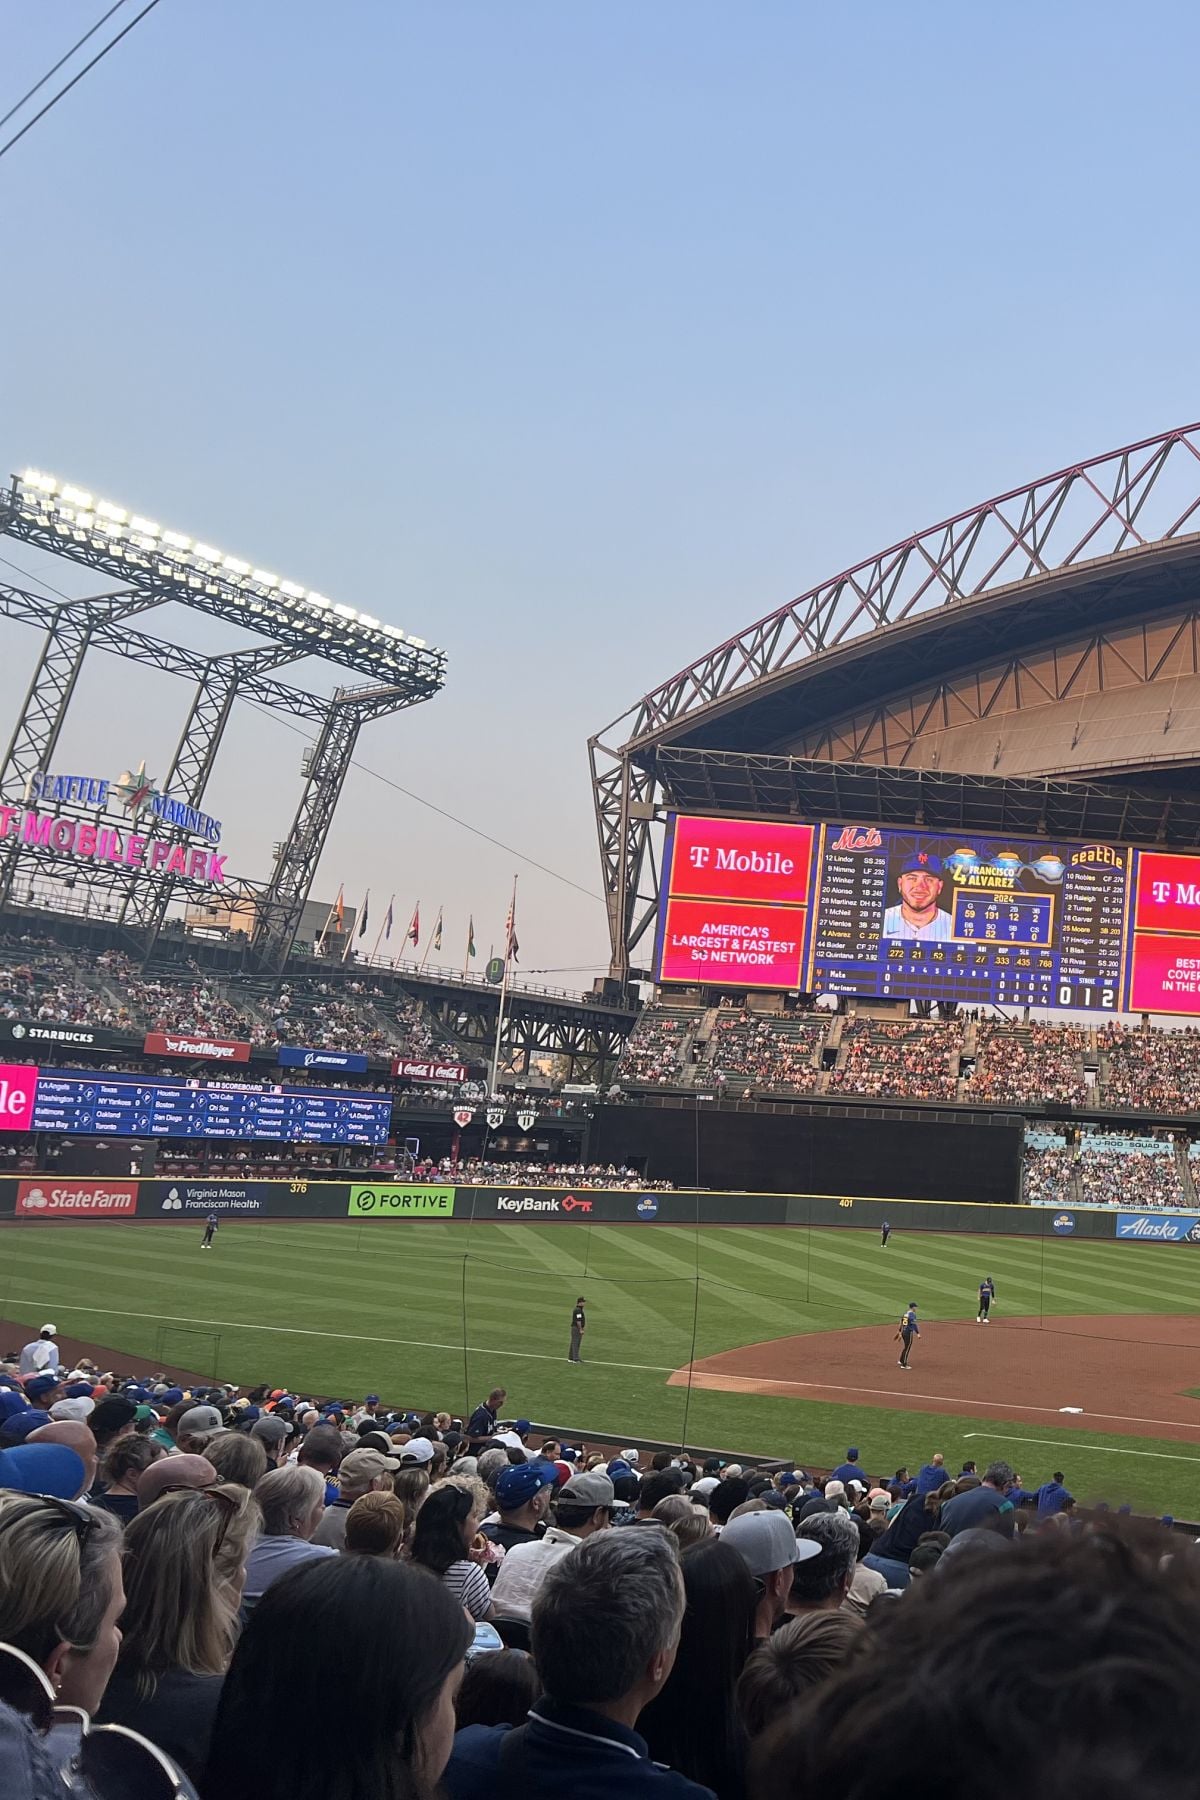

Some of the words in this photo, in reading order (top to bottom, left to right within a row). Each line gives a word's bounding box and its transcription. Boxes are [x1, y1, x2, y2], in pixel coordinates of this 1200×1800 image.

[29, 771, 110, 805] SEATTLE
[150, 791, 222, 843] MARINERS
[832, 828, 882, 850] Mets
[150, 838, 228, 884] PARK
[714, 848, 794, 875] Mobile
[969, 866, 1014, 877] FRANCISCO
[968, 876, 1015, 888] ALVAREZ
[993, 894, 1014, 903] 2024
[964, 910, 976, 918] 59
[985, 911, 999, 920] 191
[1009, 913, 1019, 921] 12
[1033, 914, 1039, 923] 2
[701, 923, 770, 939] AMERICA'S
[963, 928, 974, 936] 17
[985, 930, 996, 938] 52
[1031, 933, 1037, 941] 0
[672, 934, 730, 949] LARGEST
[732, 937, 740, 949] &
[743, 938, 796, 953] FASTEST
[690, 950, 708, 961] 5G
[711, 951, 775, 965] NETWORK
[912, 951, 922, 959] 21
[1175, 958, 1200, 970] BEST
[1042, 984, 1048, 992] 4
[1162, 981, 1172, 991] IN
[1173, 981, 1196, 992] THE
[1041, 996, 1047, 1004] 4
[1060, 986, 1072, 1005] 0
[1085, 987, 1091, 1006] 1
[1102, 989, 1114, 1007] 2
[29, 1028, 94, 1043] STARBUCKS
[221, 1082, 263, 1091] SCOREBOARD
[457, 1113, 469, 1122] 42
[490, 1115, 501, 1124] 24
[522, 1117, 530, 1126] 11
[186, 1187, 222, 1200] Virginia
[225, 1189, 246, 1199] Mason
[290, 1183, 307, 1194] 376
[186, 1199, 229, 1210] Franciscan
[230, 1200, 260, 1210] Health
[380, 1195, 448, 1209] FORTIVE
[497, 1197, 559, 1213] KeyBank
[839, 1199, 853, 1208] 401
[1120, 1217, 1179, 1237] Alaska
